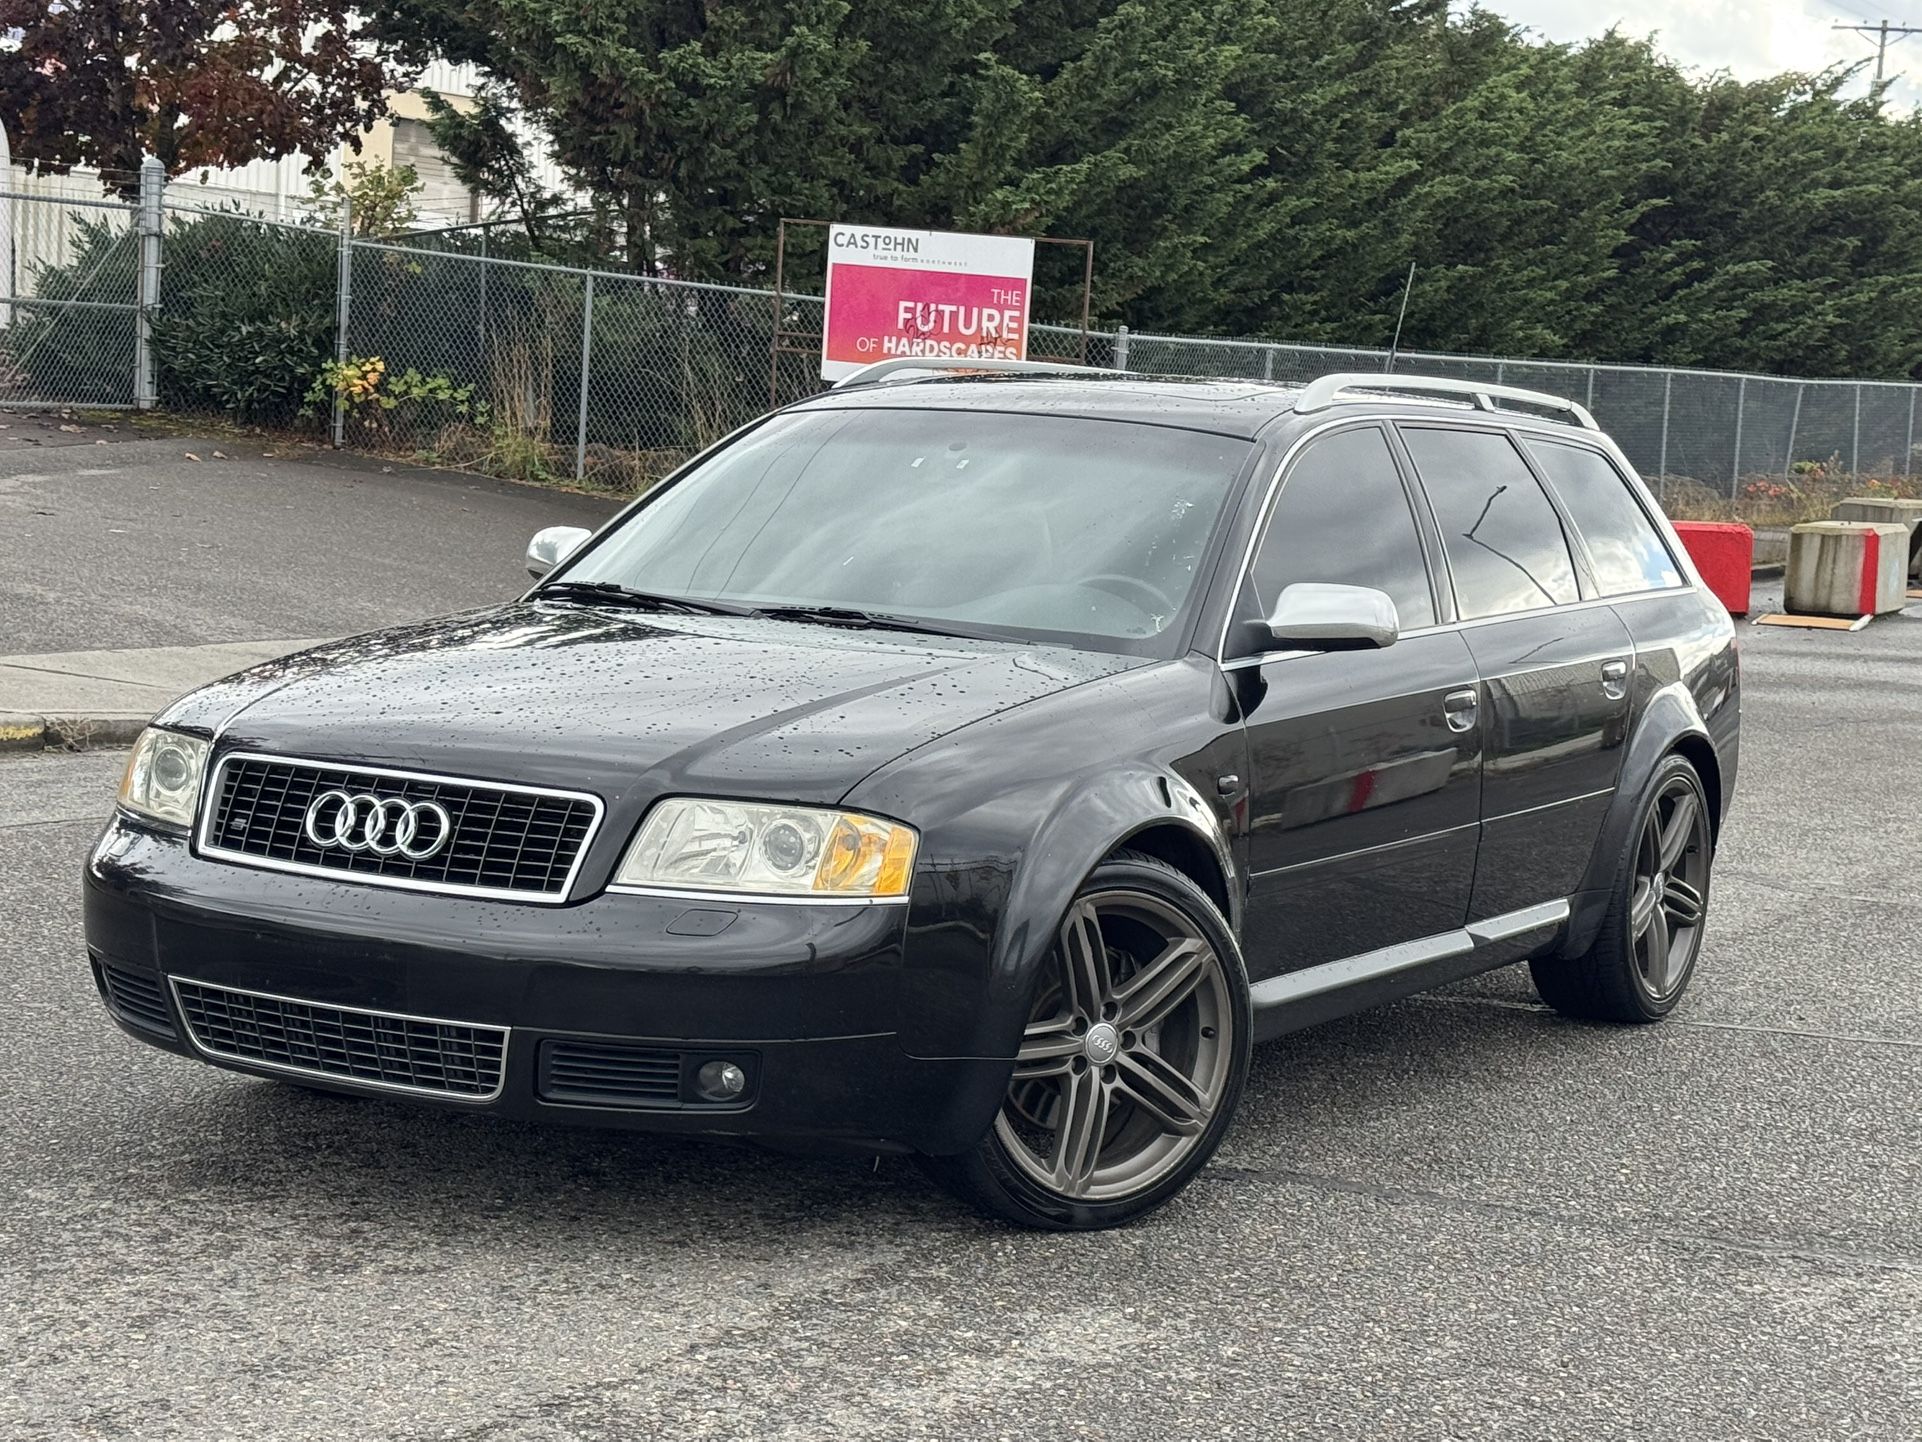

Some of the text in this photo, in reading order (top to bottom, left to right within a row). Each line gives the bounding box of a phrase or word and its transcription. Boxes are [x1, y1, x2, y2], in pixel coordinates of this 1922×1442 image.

[873, 253, 888, 261] true
[890, 254, 898, 262] to
[901, 254, 919, 264] form
[991, 288, 1021, 306] THE
[897, 300, 1021, 340] FUTURE
[856, 336, 878, 353] OF
[882, 335, 1018, 360] HARDSCAPES
